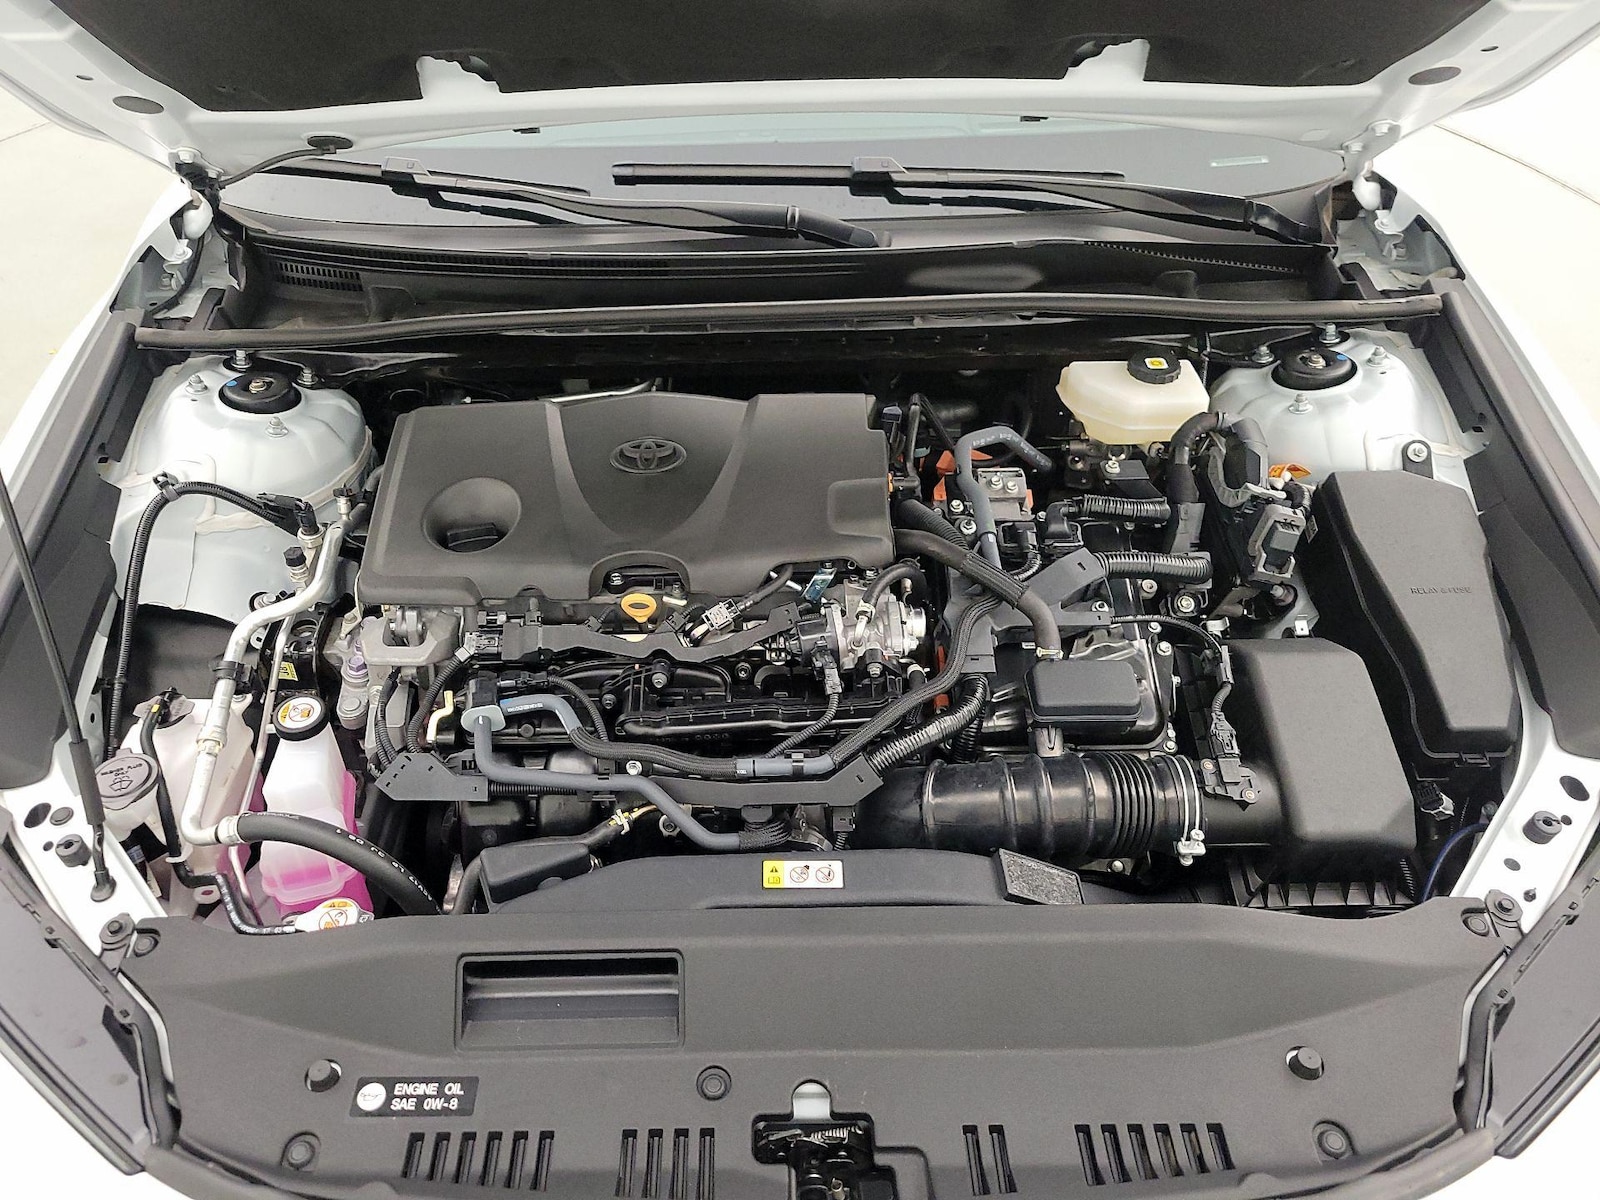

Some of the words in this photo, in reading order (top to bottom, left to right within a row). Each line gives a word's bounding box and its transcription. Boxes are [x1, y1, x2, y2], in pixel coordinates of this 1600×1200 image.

[1409, 586, 1438, 595] RELAY
[1448, 586, 1472, 594] FUSE
[394, 1083, 439, 1096] ENGINE
[444, 1083, 464, 1095] OIL
[390, 1097, 418, 1111] SAE
[423, 1098, 458, 1110] 0W-8
